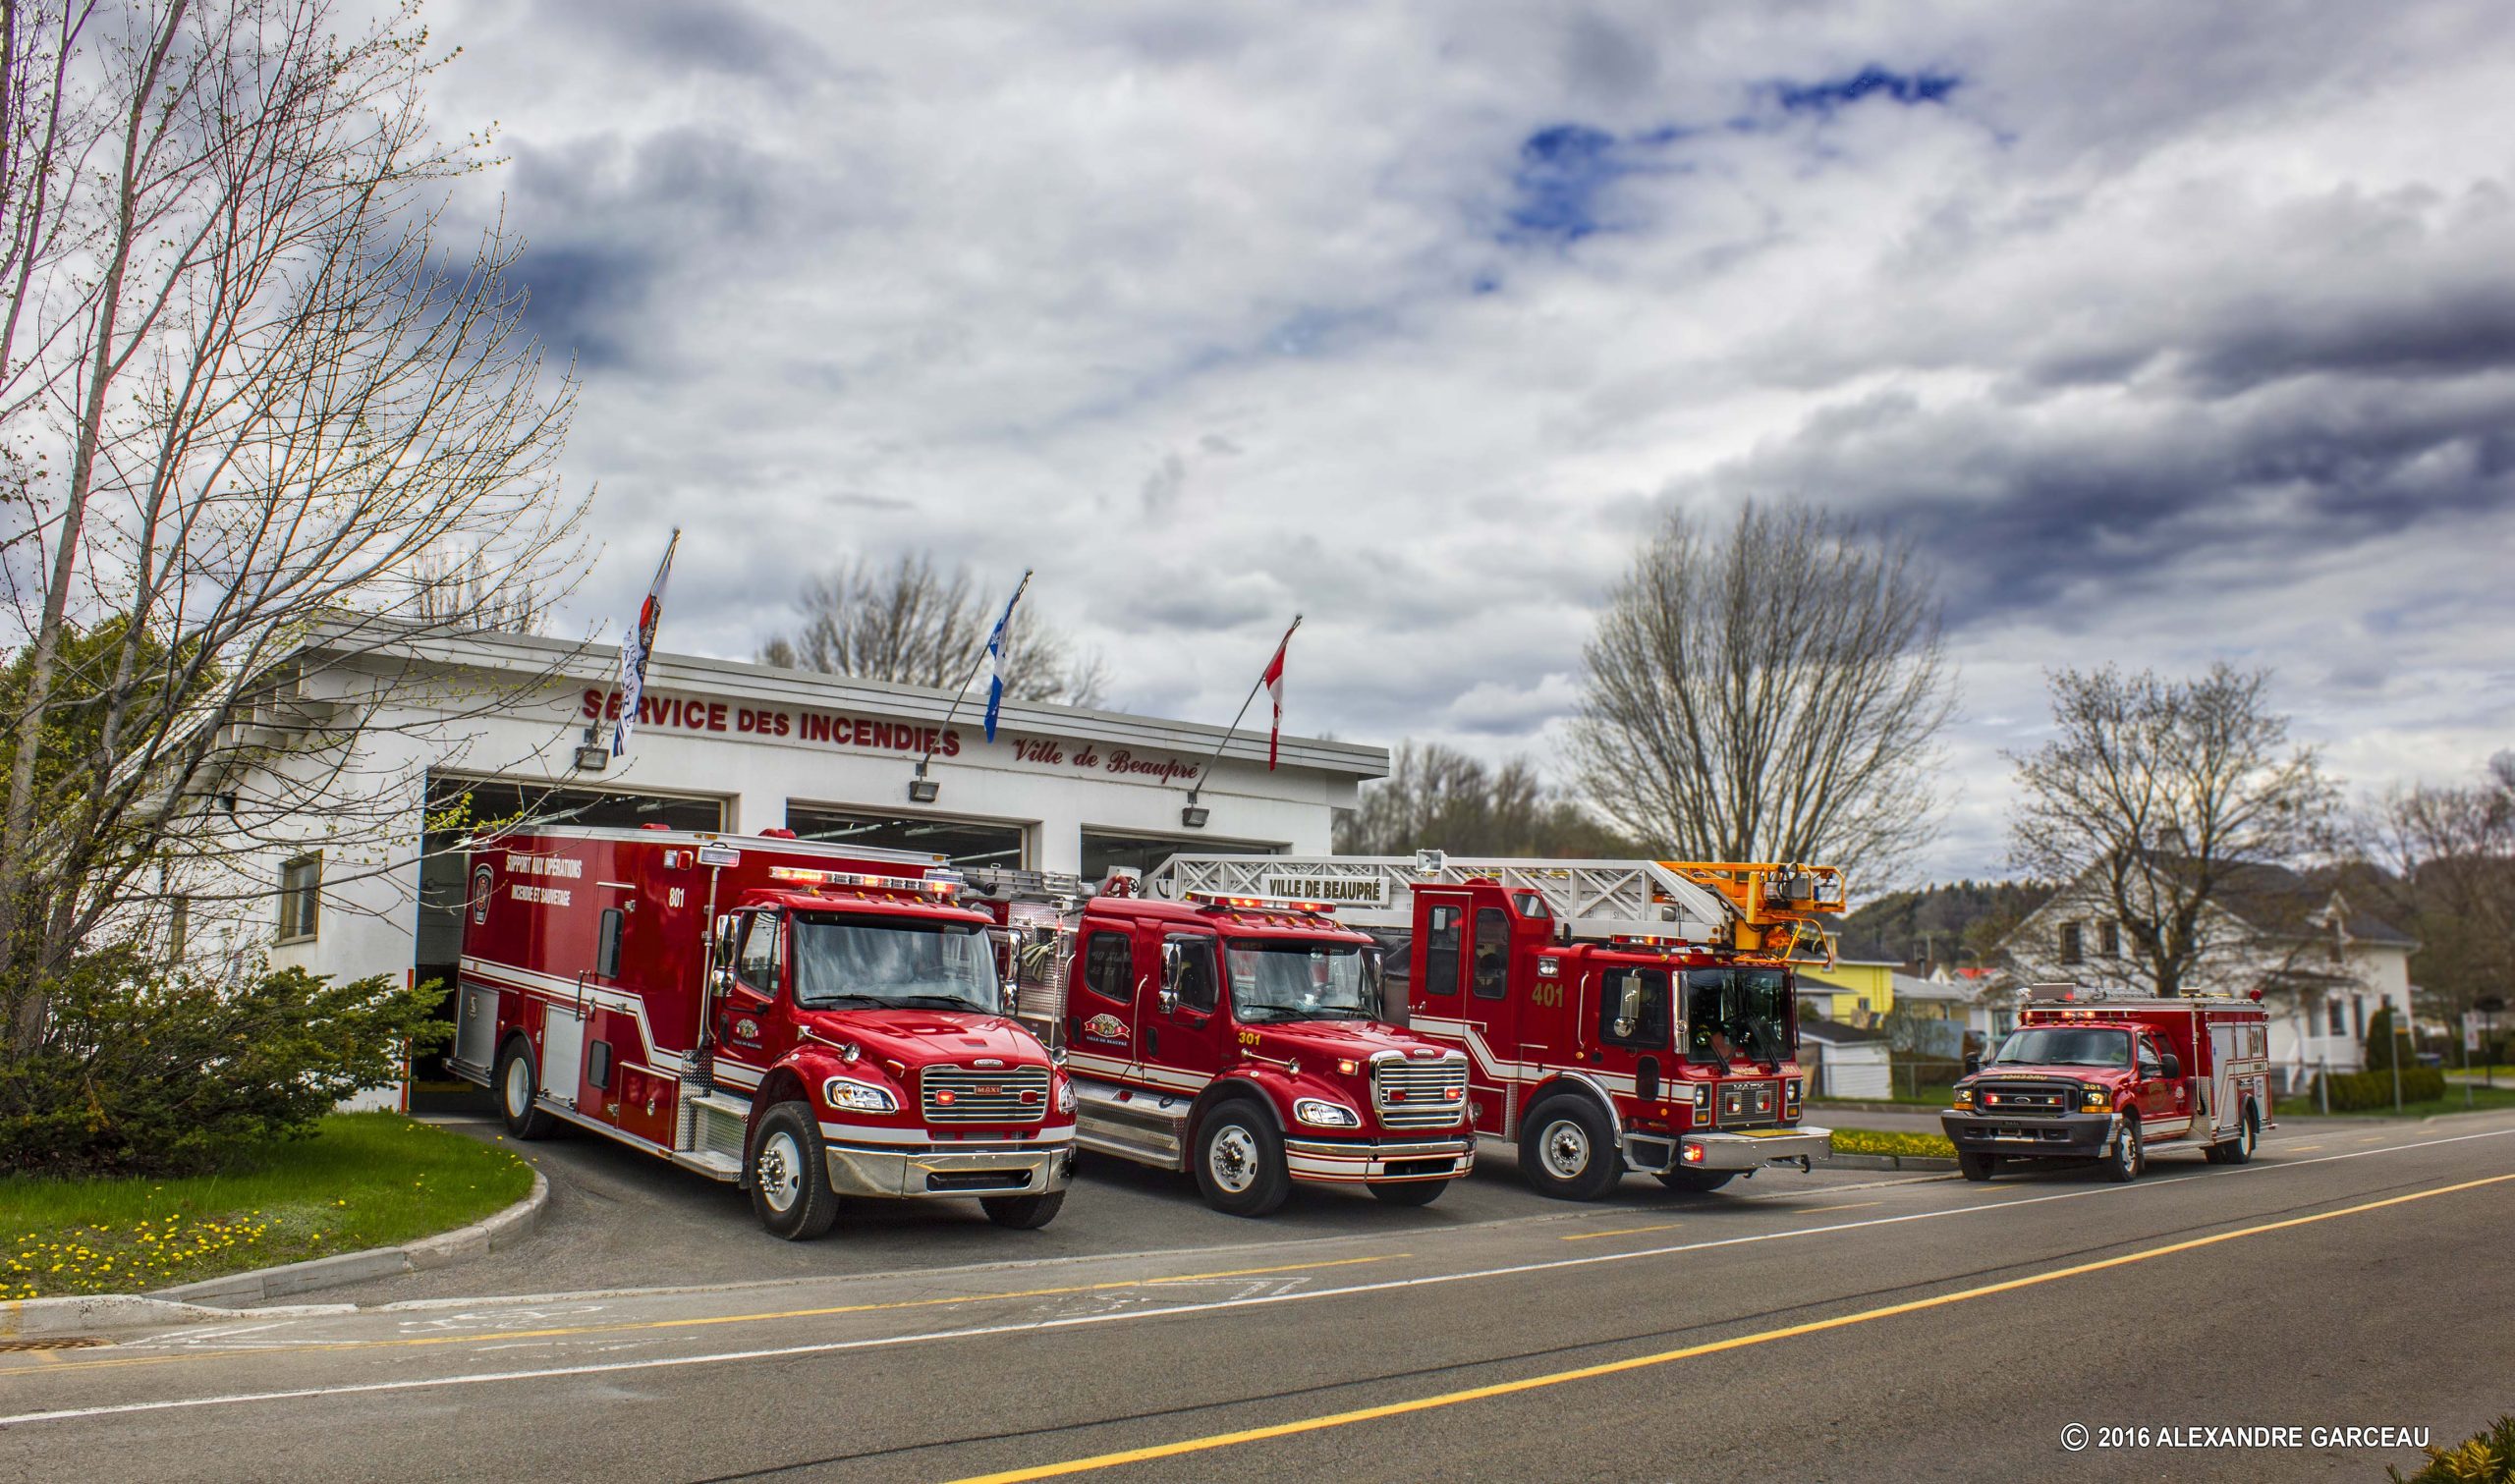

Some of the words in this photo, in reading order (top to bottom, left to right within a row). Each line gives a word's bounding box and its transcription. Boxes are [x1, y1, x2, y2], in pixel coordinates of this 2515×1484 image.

[582, 688, 728, 732] SERVICE
[738, 708, 790, 737] DES
[800, 712, 960, 757] INCENDIES
[1012, 739, 1063, 764] Ville
[1073, 744, 1098, 767] de
[1107, 749, 1201, 784] Beaupré
[506, 854, 531, 873] SUPPORT
[531, 856, 544, 875] AUX
[544, 853, 582, 879] OPÉRATIONS
[511, 884, 533, 902] INCENDIE
[533, 887, 540, 903] ET
[540, 887, 571, 907] SAUVETAGE
[669, 887, 685, 907] 801
[1269, 879, 1302, 898] VILLE
[1305, 880, 1320, 899] DE
[1323, 878, 1381, 901] BEAUPRÉ
[1532, 982, 1564, 1008] 401
[1238, 1031, 1261, 1046] 301
[1733, 1082, 1764, 1091] MACK
